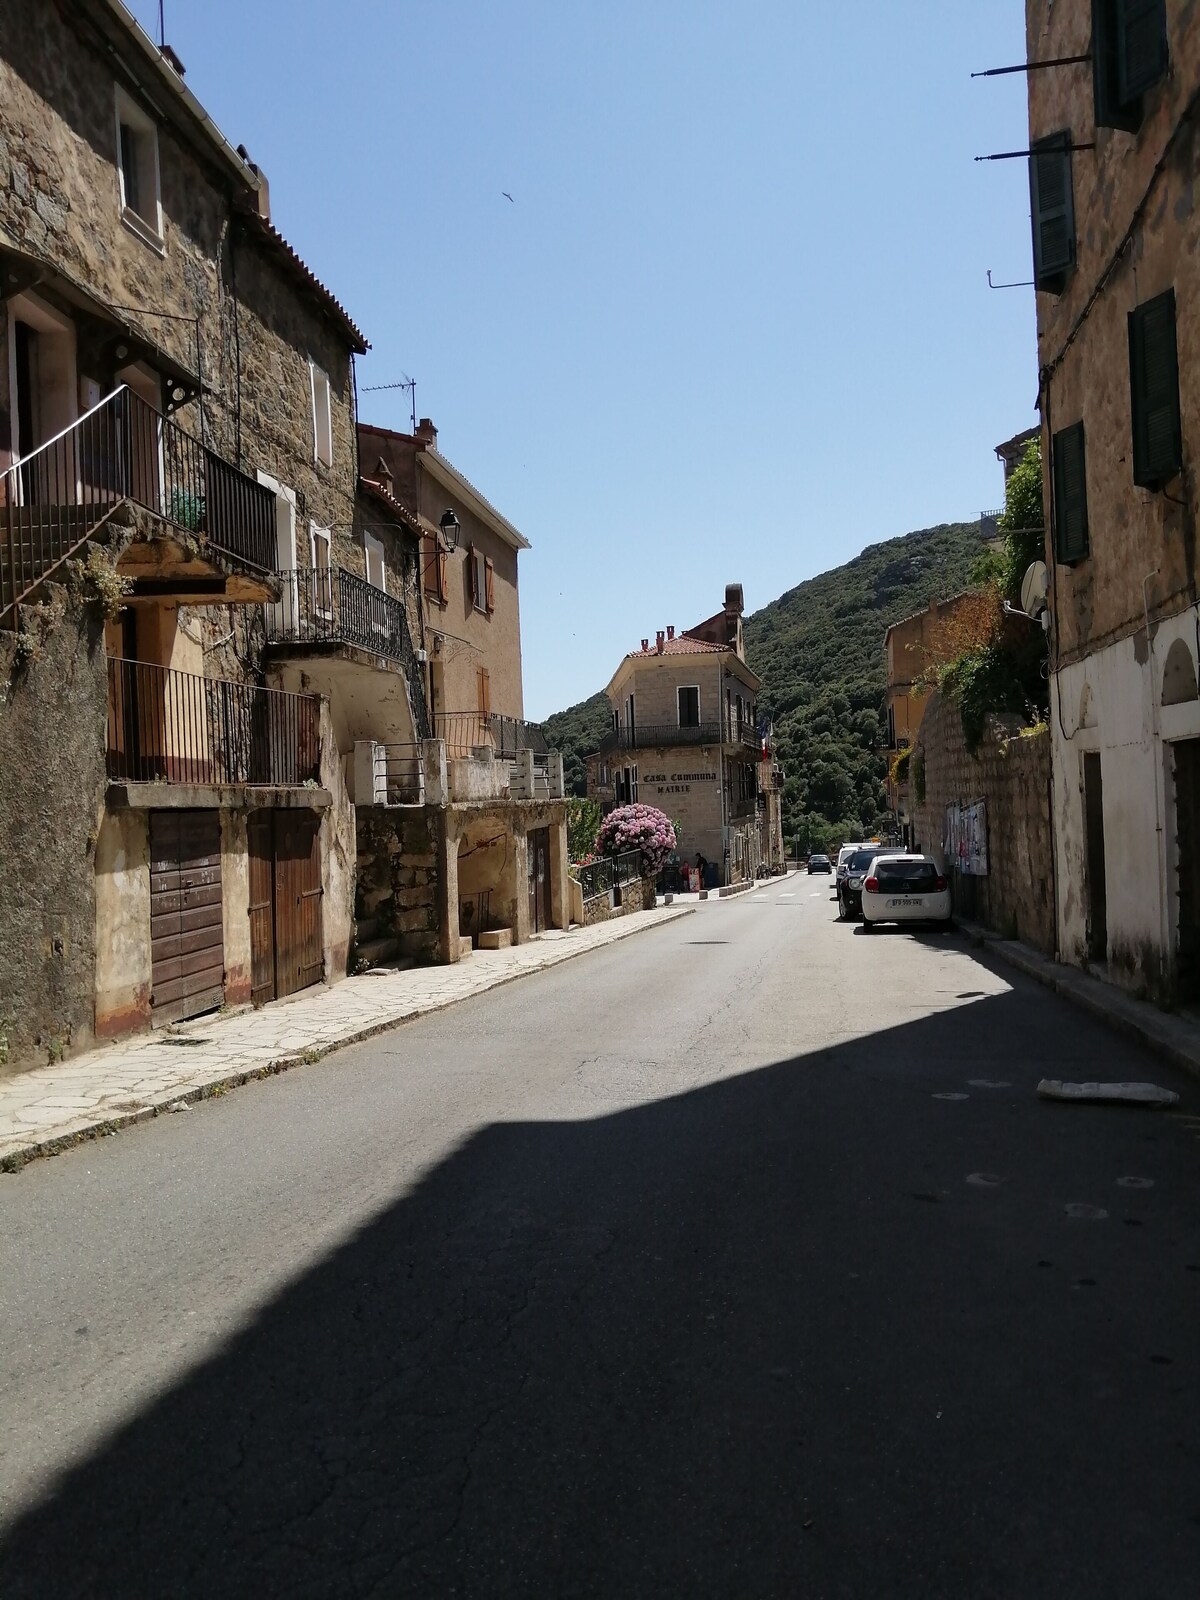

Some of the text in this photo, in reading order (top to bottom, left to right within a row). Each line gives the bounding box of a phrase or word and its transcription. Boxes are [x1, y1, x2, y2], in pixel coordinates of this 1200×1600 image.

[643, 772, 717, 783] Casa Cummuna
[657, 784, 690, 794] MAIRIE
